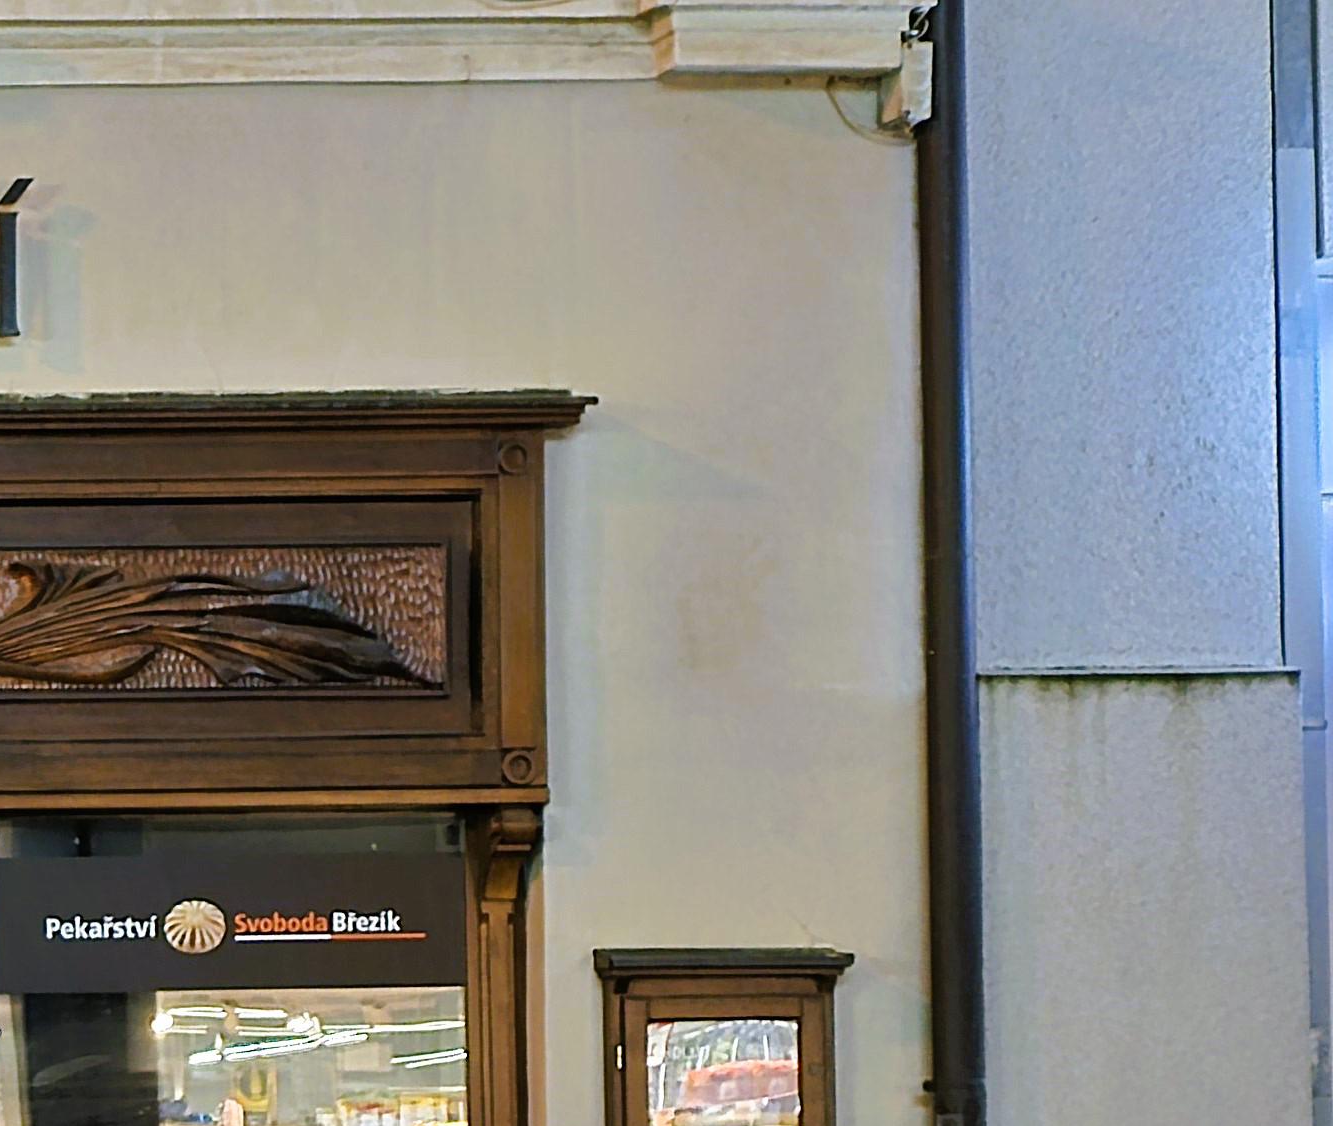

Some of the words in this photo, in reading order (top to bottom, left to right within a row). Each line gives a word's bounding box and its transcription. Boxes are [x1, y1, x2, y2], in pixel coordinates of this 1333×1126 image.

[45, 914, 159, 940] Pekařství
[233, 911, 328, 934] Svoboda
[331, 909, 402, 933] Březík
